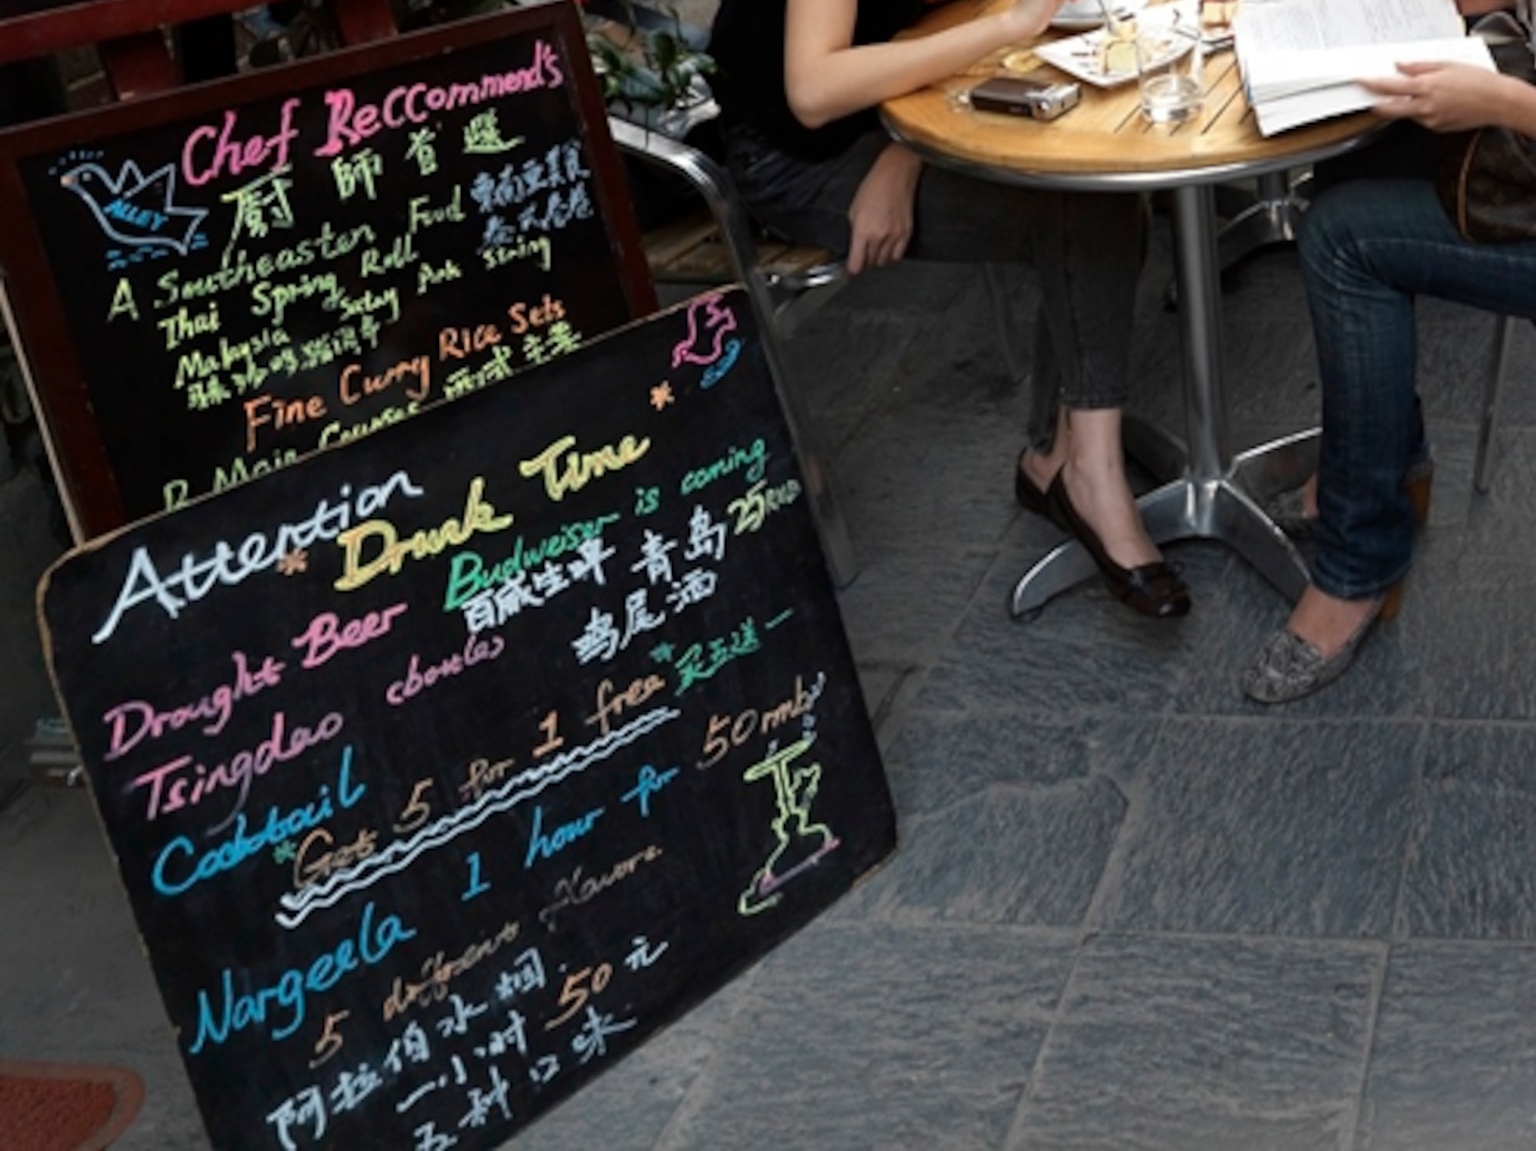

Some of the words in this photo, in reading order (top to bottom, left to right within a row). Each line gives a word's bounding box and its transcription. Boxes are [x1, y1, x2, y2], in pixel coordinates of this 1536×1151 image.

[181, 97, 300, 186] Chef
[103, 197, 168, 232] ALLEY
[408, 185, 467, 236] Food
[107, 277, 140, 322] A
[157, 302, 222, 349] Thai
[250, 271, 343, 327] Spring
[360, 233, 419, 278] Roll
[243, 393, 328, 451] Fine
[340, 354, 430, 405] Curry
[438, 323, 503, 362] Rice
[507, 293, 567, 334] Sets
[519, 435, 651, 502] Time
[92, 469, 424, 645] Attention
[443, 511, 622, 611] Budweiser
[634, 486, 661, 517] is
[679, 437, 771, 497] coming
[291, 602, 409, 669] Beer
[122, 711, 344, 837] Tsingdao
[393, 777, 432, 834] 5
[532, 709, 564, 757] 1
[583, 671, 667, 735] free
[189, 901, 418, 1055] Nargeela
[460, 851, 492, 902] 1
[546, 962, 613, 1032] 50
[308, 1009, 351, 1070] 5
